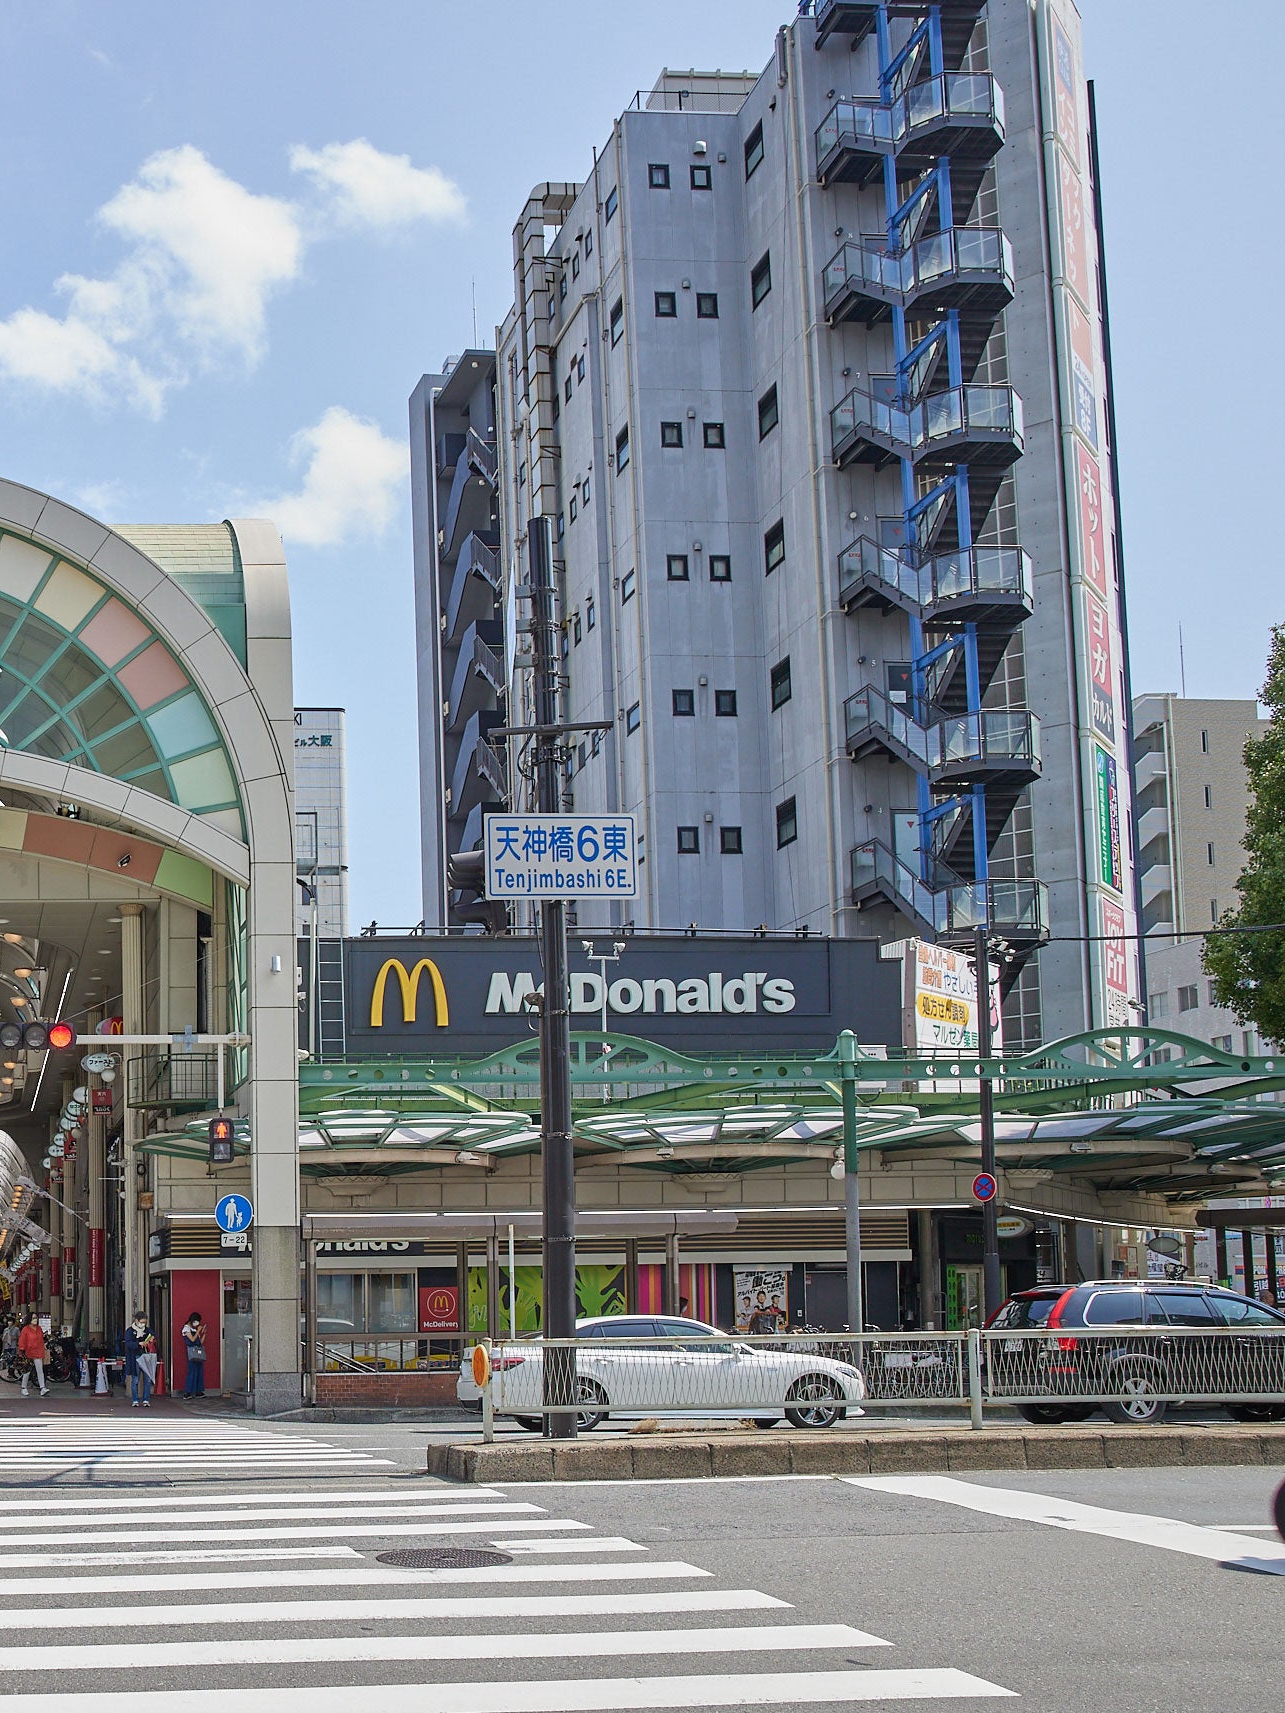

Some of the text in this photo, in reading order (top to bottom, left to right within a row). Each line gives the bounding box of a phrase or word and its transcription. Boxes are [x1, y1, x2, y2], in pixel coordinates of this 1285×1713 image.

[1083, 463, 1100, 579] ホット
[1092, 604, 1108, 684] ヨガ
[495, 824, 628, 862] 天神橋6東
[495, 869, 632, 892] Tenjimbashi 6E.
[1105, 920, 1123, 952] JOY
[223, 1236, 245, 1244] 7-22
